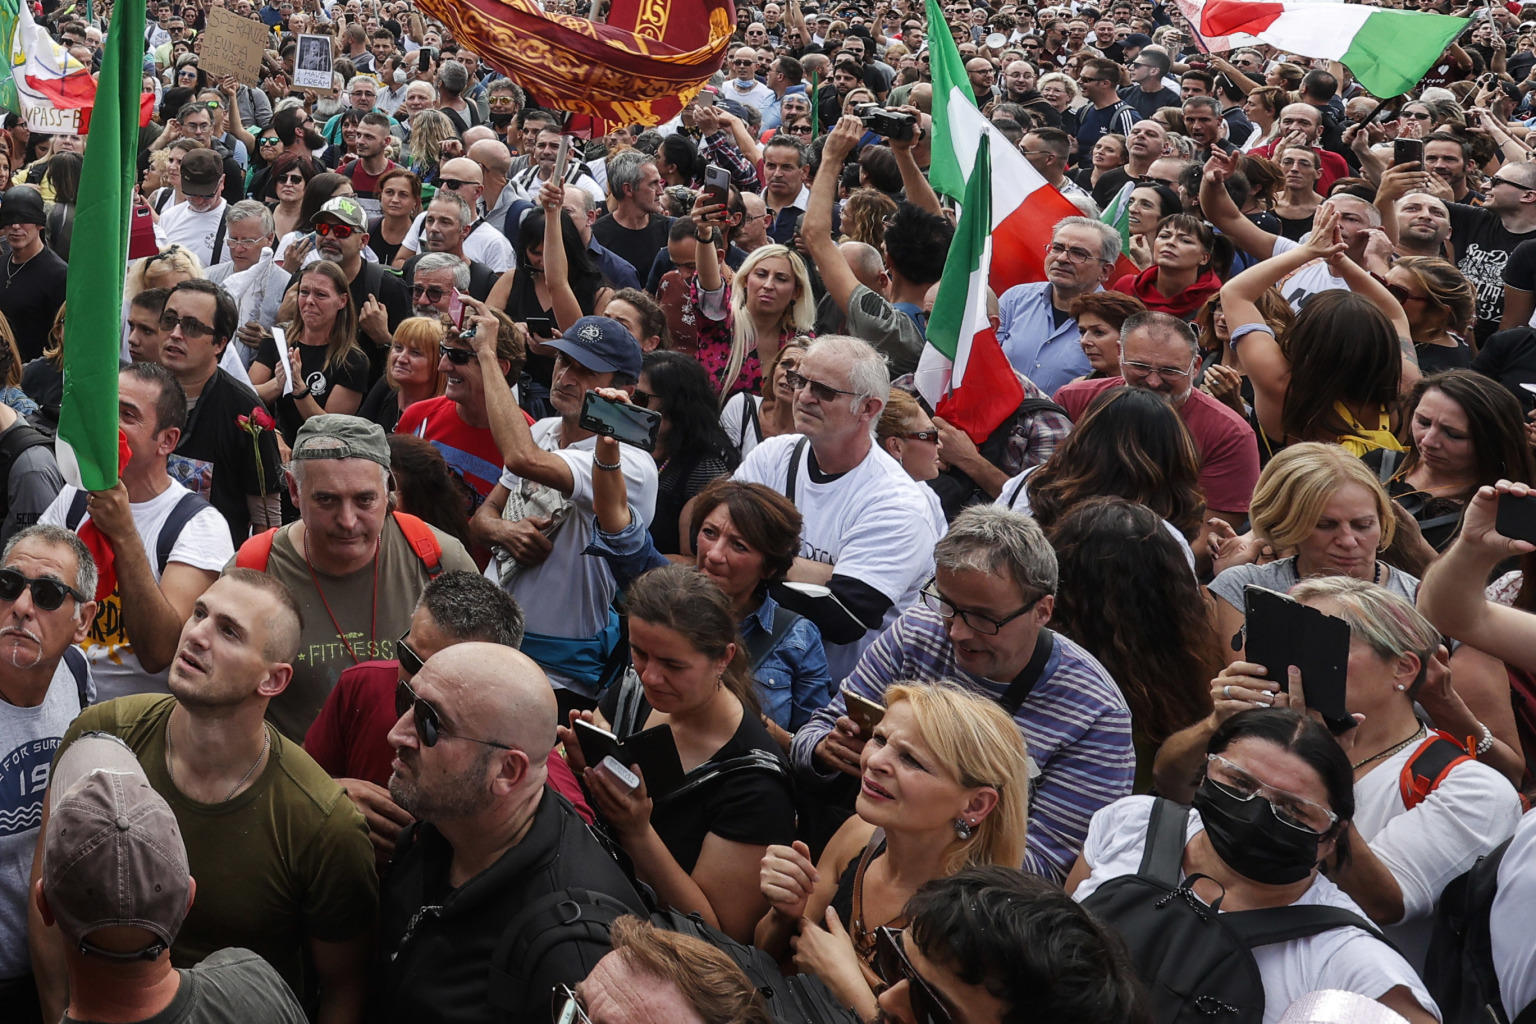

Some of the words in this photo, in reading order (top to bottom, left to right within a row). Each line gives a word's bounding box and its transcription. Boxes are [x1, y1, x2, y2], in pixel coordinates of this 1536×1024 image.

[305, 78, 330, 86] DREAM
[309, 640, 394, 667] FITNESS
[3, 746, 30, 772] FOR
